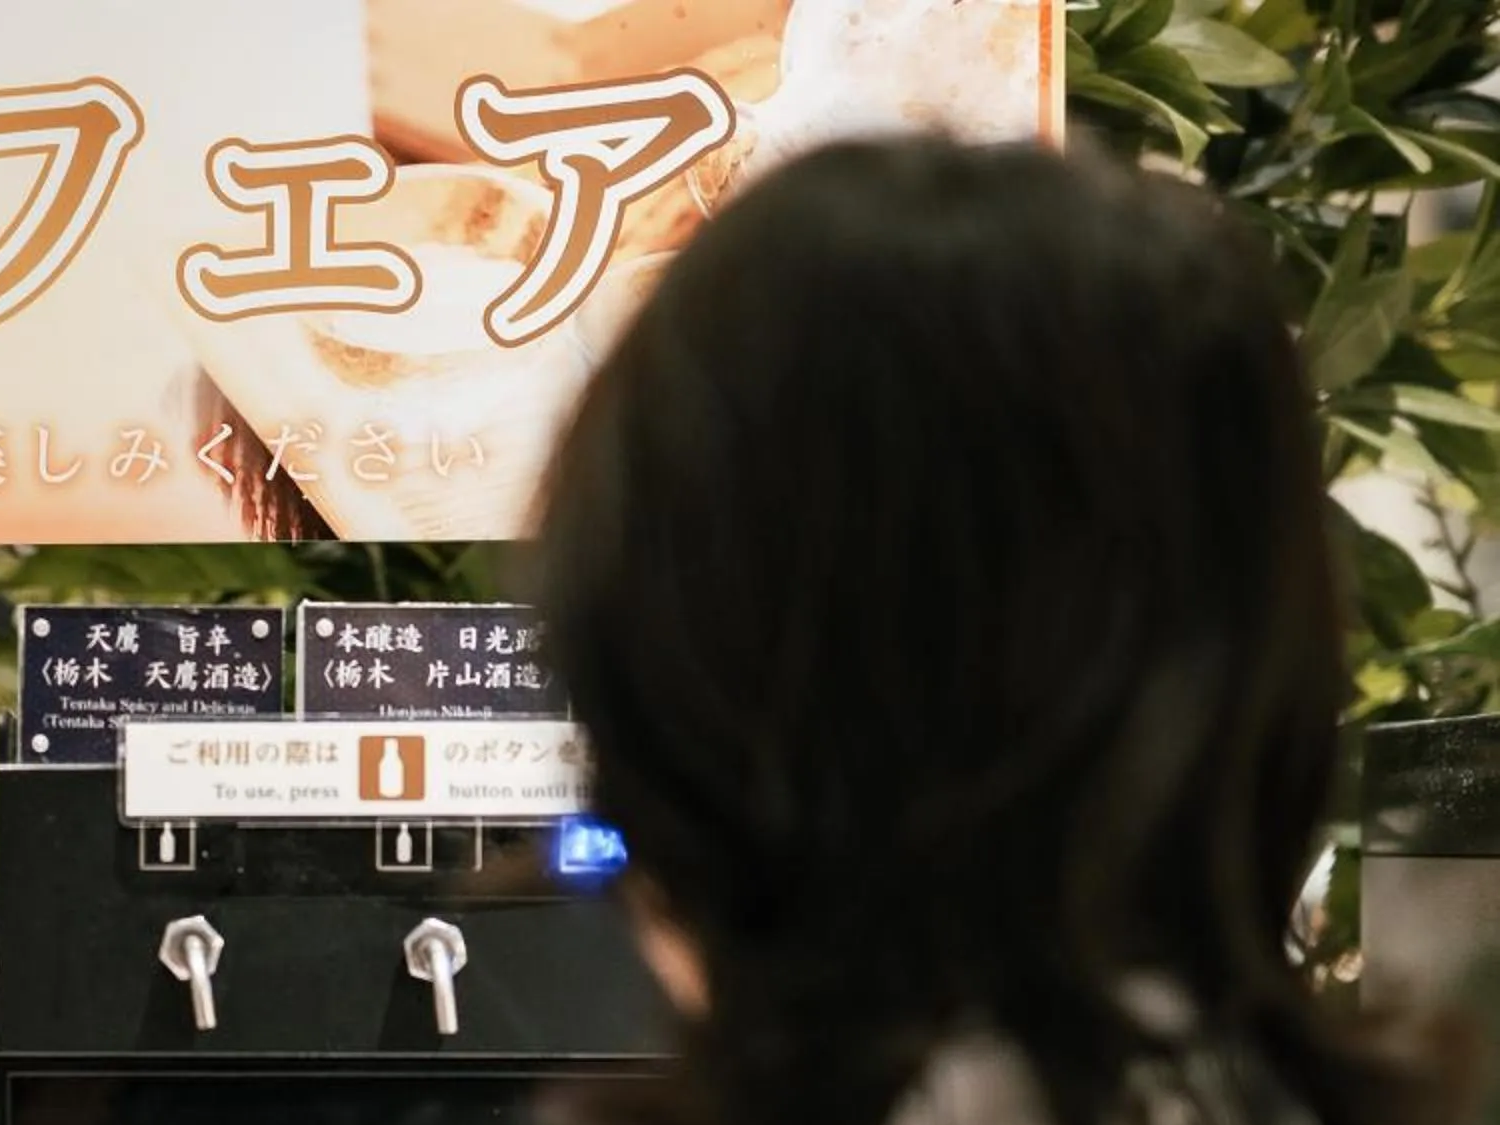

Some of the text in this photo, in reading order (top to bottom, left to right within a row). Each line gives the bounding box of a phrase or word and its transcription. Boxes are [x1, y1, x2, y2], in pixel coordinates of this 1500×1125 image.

[86, 623, 231, 656] 天鷹 旨辛
[336, 623, 424, 653] 本醸造
[59, 696, 117, 711] Tentaka
[119, 697, 159, 714] Spicy
[161, 699, 188, 713] and
[168, 738, 339, 766] ご利用の際は
[213, 782, 238, 800] To
[245, 785, 282, 801] use,
[290, 785, 340, 802] press
[449, 783, 513, 799] button
[521, 783, 568, 799] until
